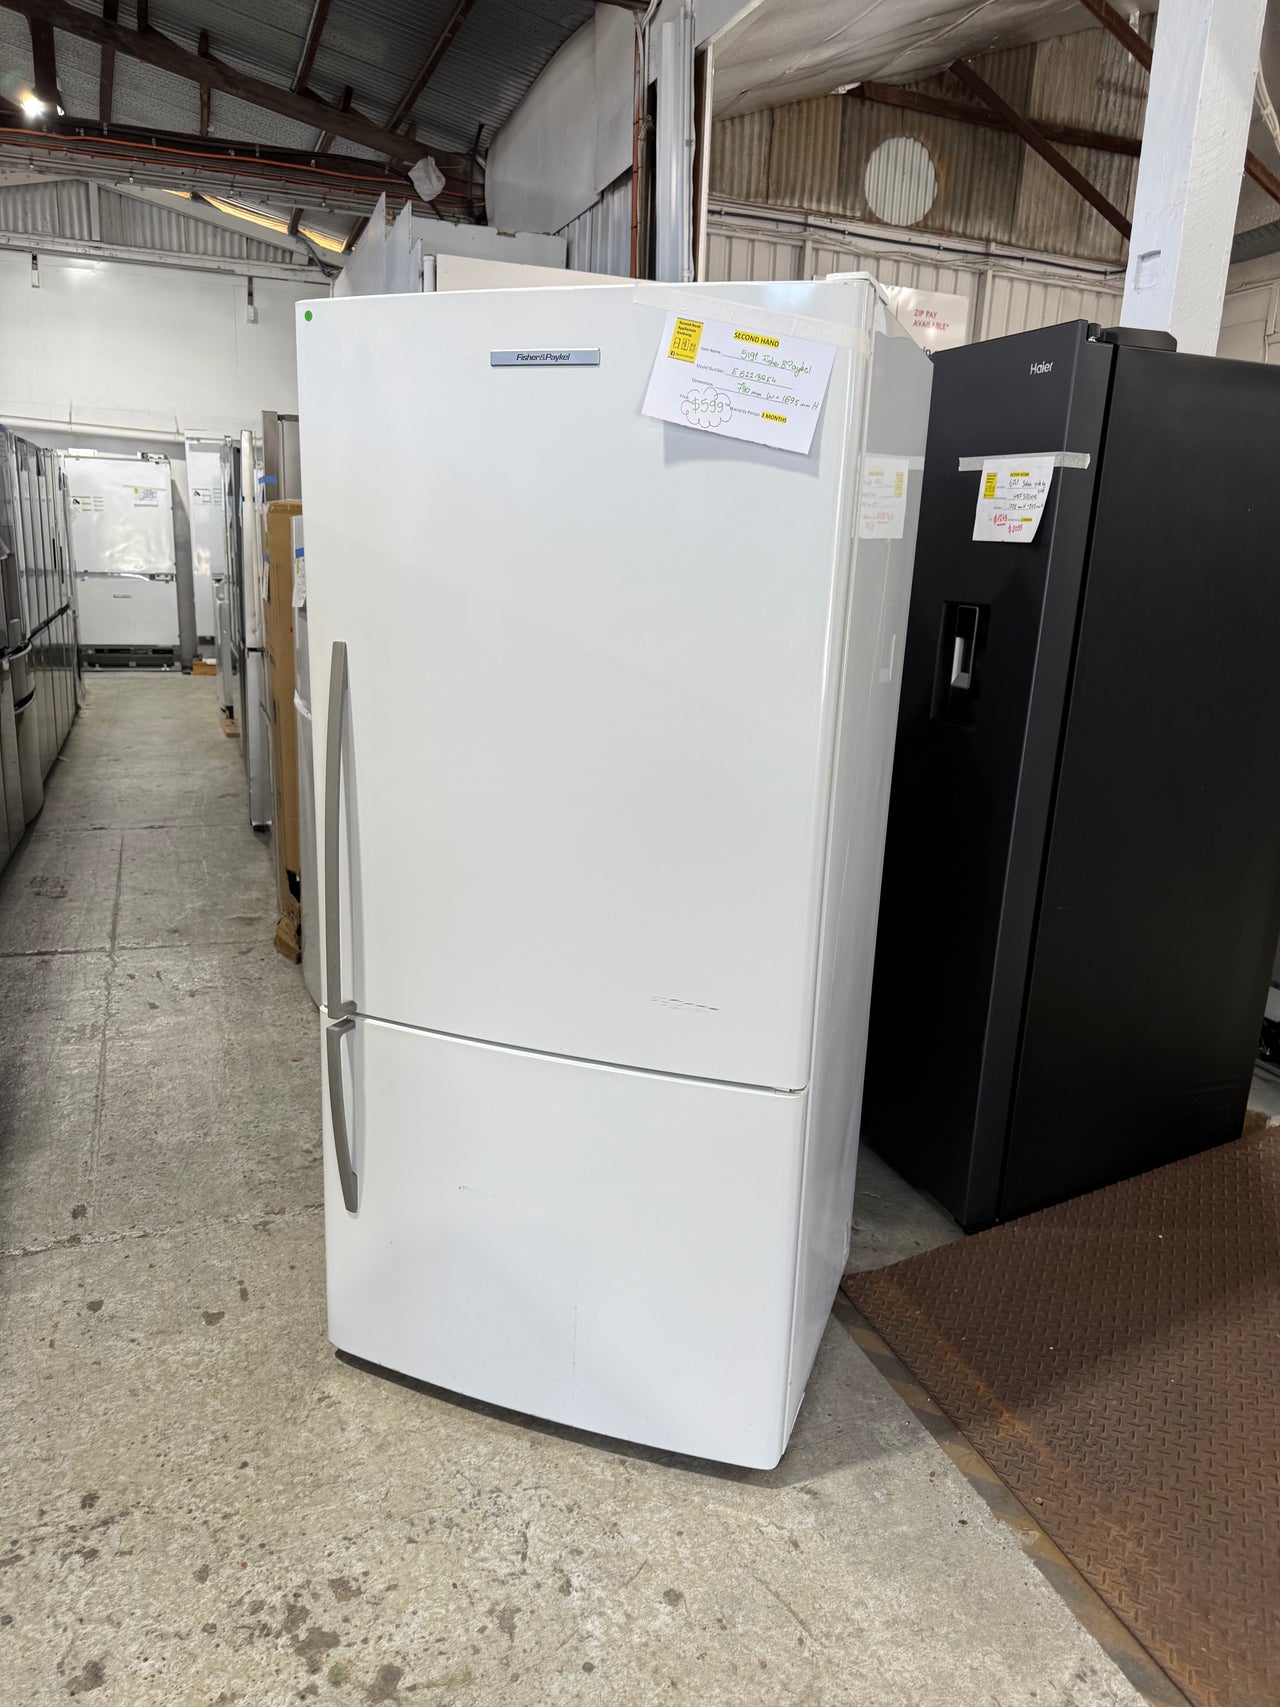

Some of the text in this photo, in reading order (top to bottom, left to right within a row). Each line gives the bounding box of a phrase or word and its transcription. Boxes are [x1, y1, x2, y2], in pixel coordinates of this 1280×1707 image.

[914, 309, 937, 319] ZIP PAY
[733, 331, 779, 348] SECOND HAND
[516, 352, 571, 363] Fisher&Paykel
[1030, 360, 1054, 376] Haier
[691, 396, 724, 414] $599
[765, 414, 786, 423] MONTHS
